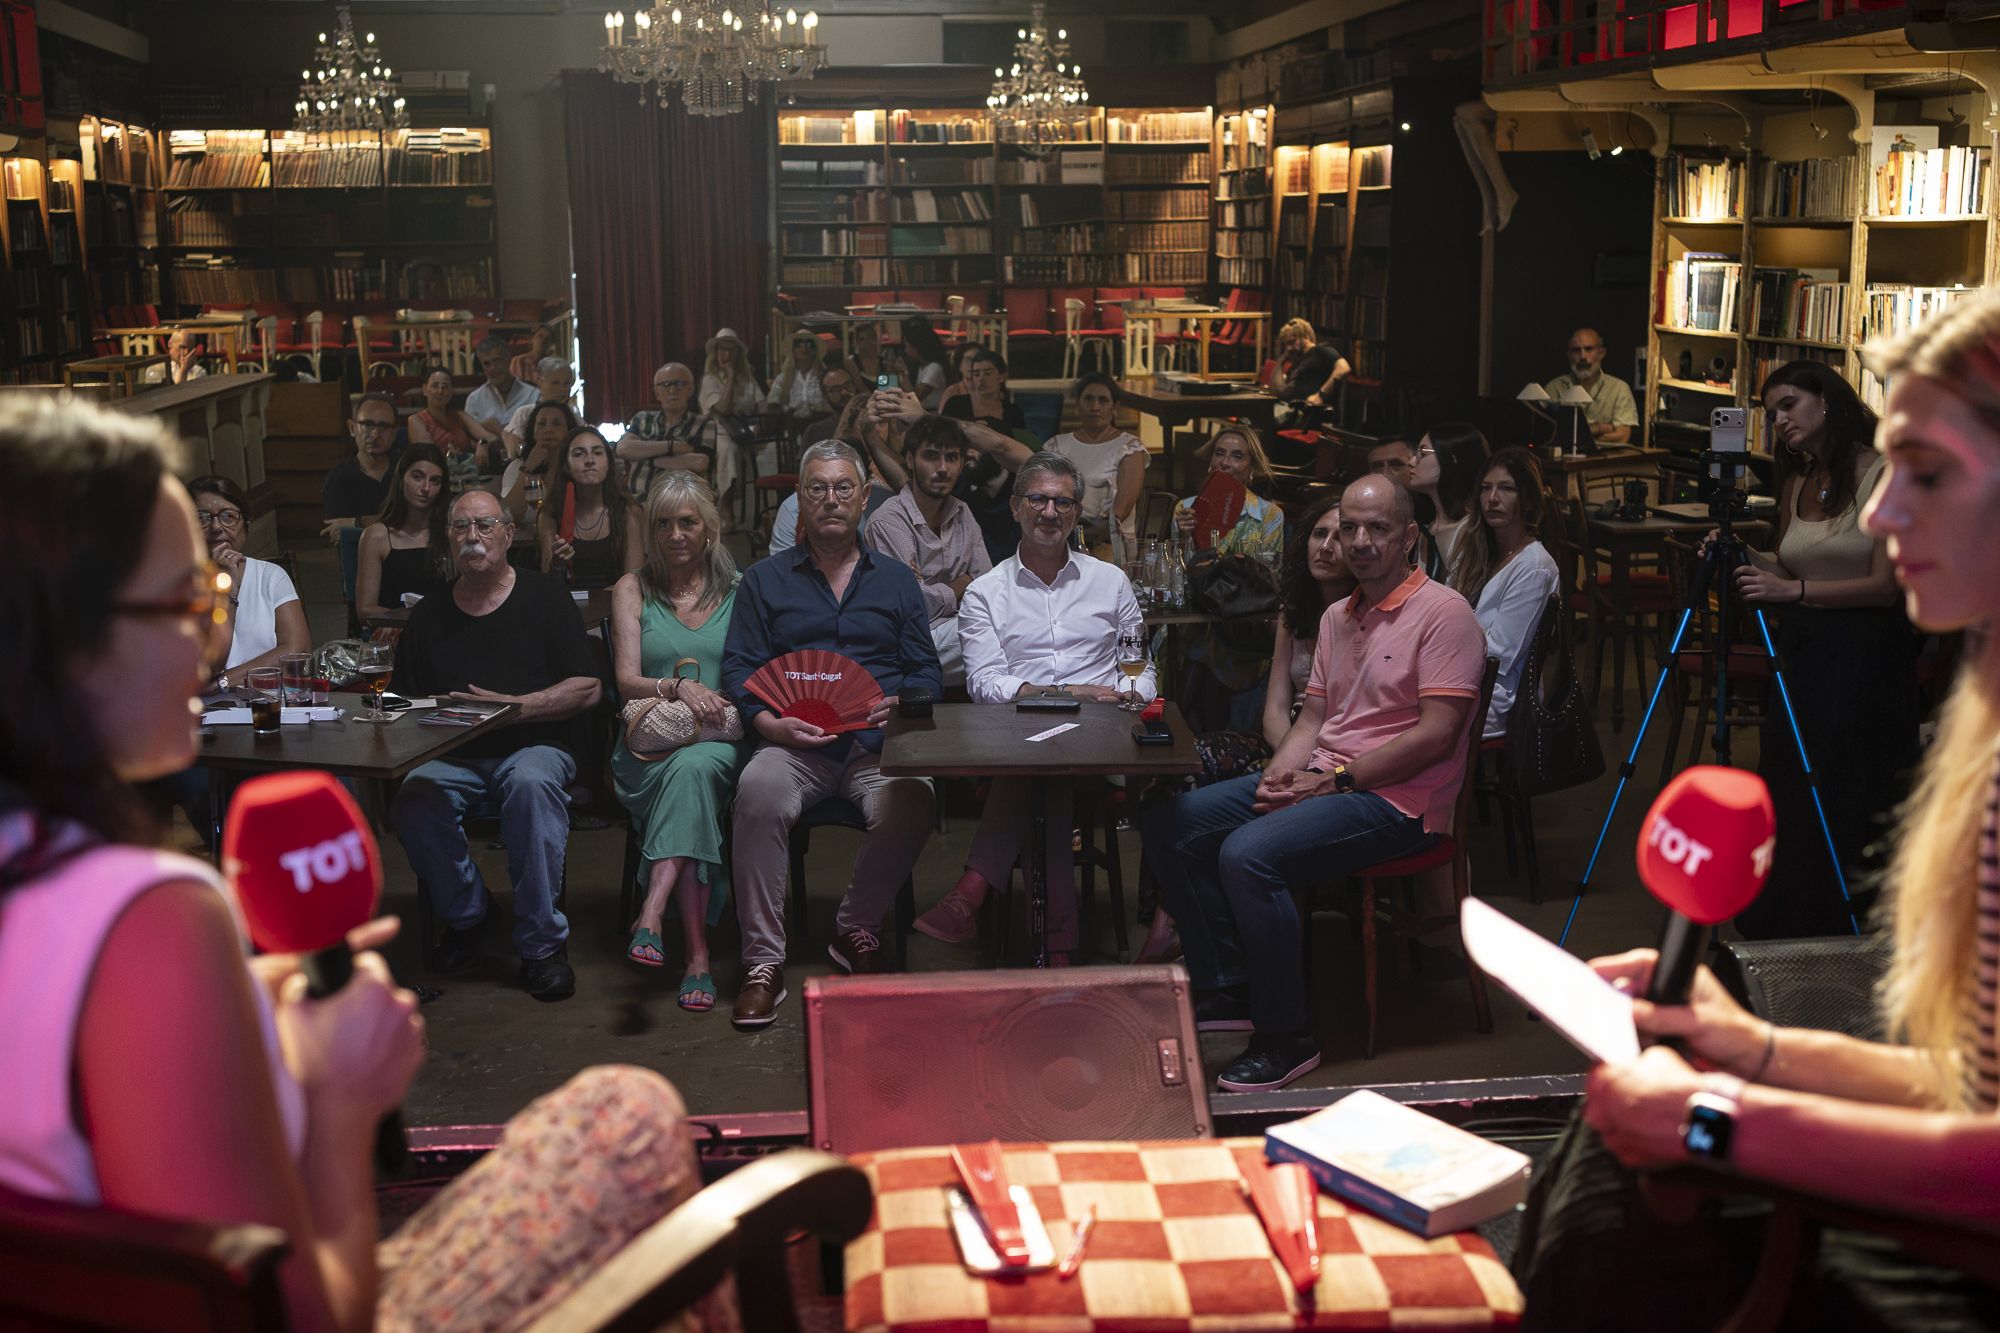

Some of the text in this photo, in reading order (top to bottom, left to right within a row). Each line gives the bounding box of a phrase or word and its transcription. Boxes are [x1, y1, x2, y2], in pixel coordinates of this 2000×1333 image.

[785, 671, 801, 680] TOT
[820, 672, 842, 682] Cugat
[279, 829, 366, 893] TOT
[1650, 814, 1712, 876] TOT
